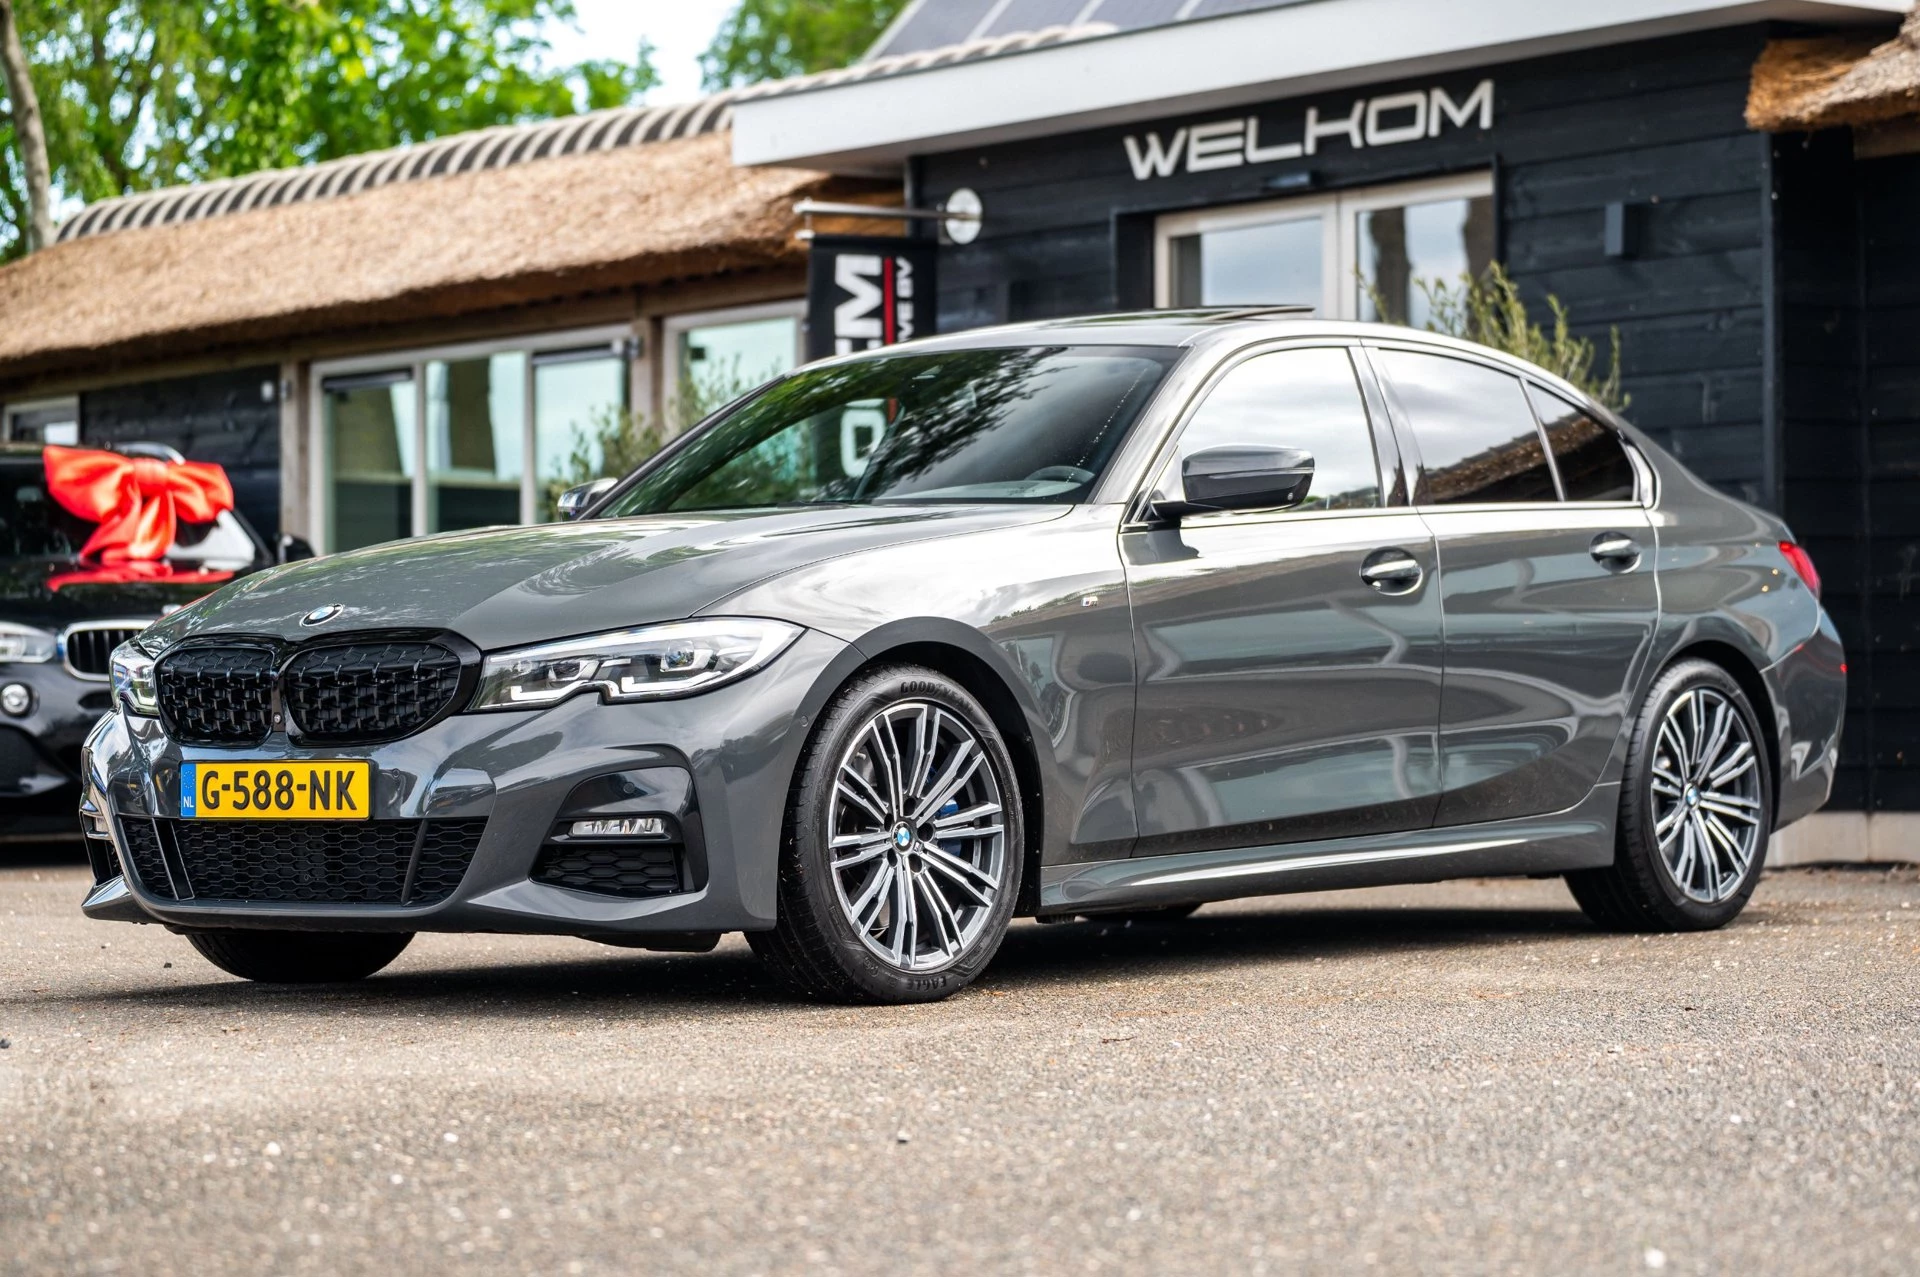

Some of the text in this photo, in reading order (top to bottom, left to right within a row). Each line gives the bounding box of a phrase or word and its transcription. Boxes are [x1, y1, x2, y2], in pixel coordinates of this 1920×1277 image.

[1123, 79, 1494, 181] WELKOM
[896, 256, 914, 298] BV
[183, 769, 357, 811] NL G-588-NK
